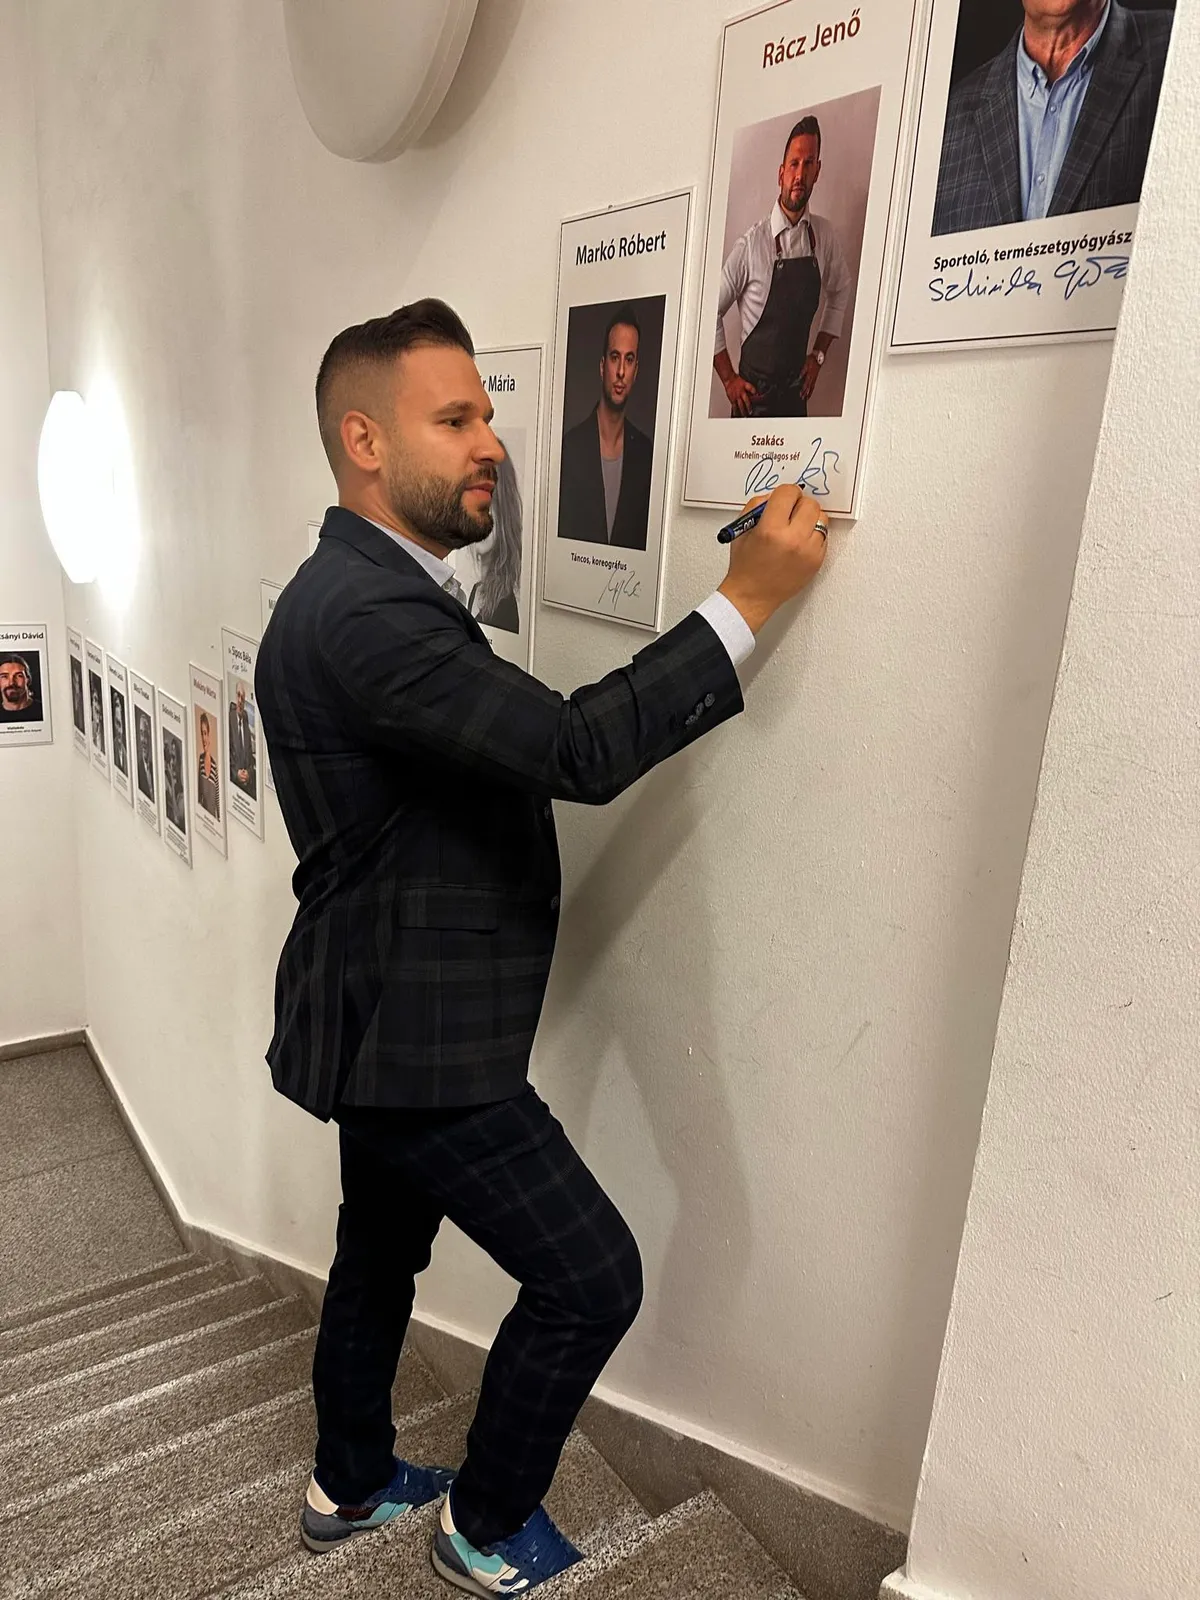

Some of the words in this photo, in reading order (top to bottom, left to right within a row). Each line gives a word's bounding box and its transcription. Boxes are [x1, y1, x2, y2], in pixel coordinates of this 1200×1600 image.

[762, 36, 807, 69] Rácz
[810, 8, 861, 52] Jenő
[576, 238, 616, 266] Markó
[618, 230, 667, 258] Róbert
[933, 249, 991, 273] Sportoló,
[994, 229, 1133, 262] természetgyógyász
[487, 374, 516, 392] Mária
[751, 434, 785, 447] Szakács
[733, 450, 789, 463] Michelin-csillagos
[789, 451, 801, 461] séf
[570, 552, 591, 565] Táncos,
[591, 556, 628, 571] koreográfus
[21, 632, 45, 640] Dávid
